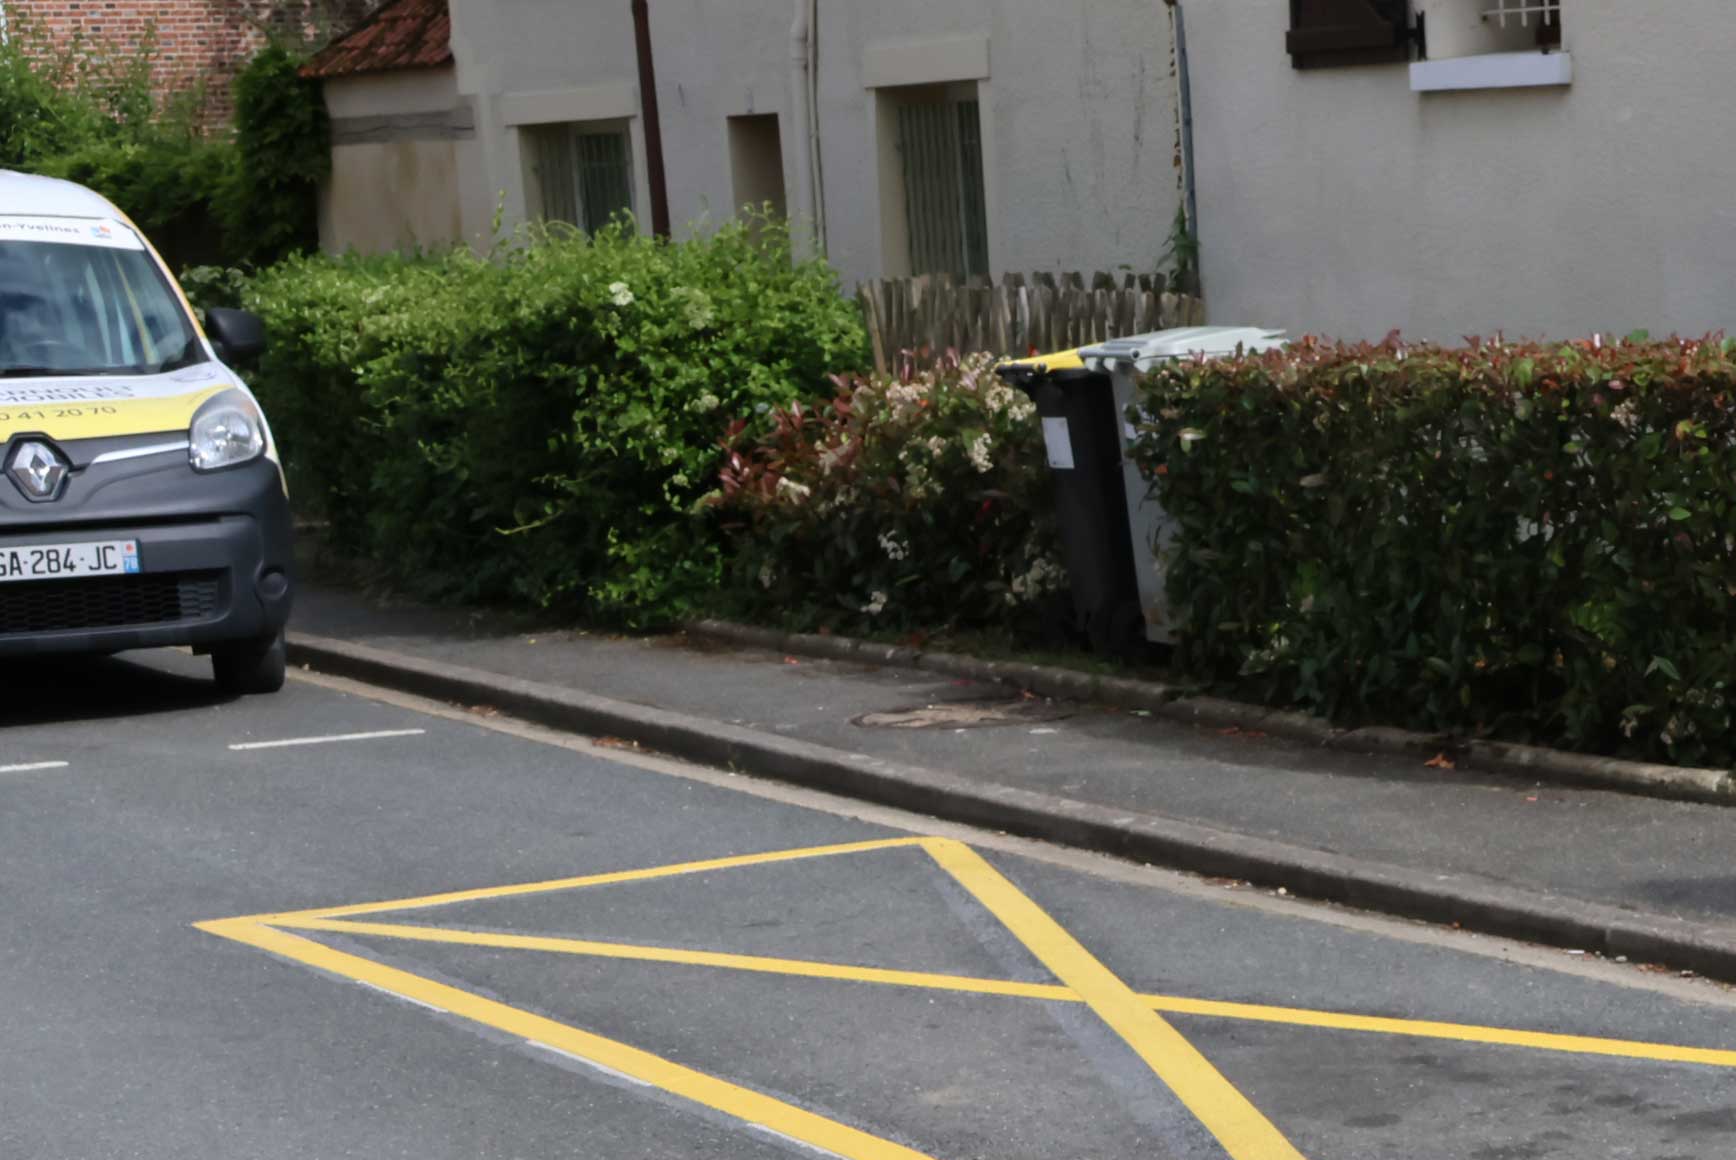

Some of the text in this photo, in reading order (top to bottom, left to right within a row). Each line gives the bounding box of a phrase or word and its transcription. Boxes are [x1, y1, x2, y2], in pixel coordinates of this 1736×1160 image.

[0, 223, 80, 234] n-Yvelines
[18, 411, 45, 420] 41
[55, 408, 83, 418] 20
[86, 406, 117, 415] 70
